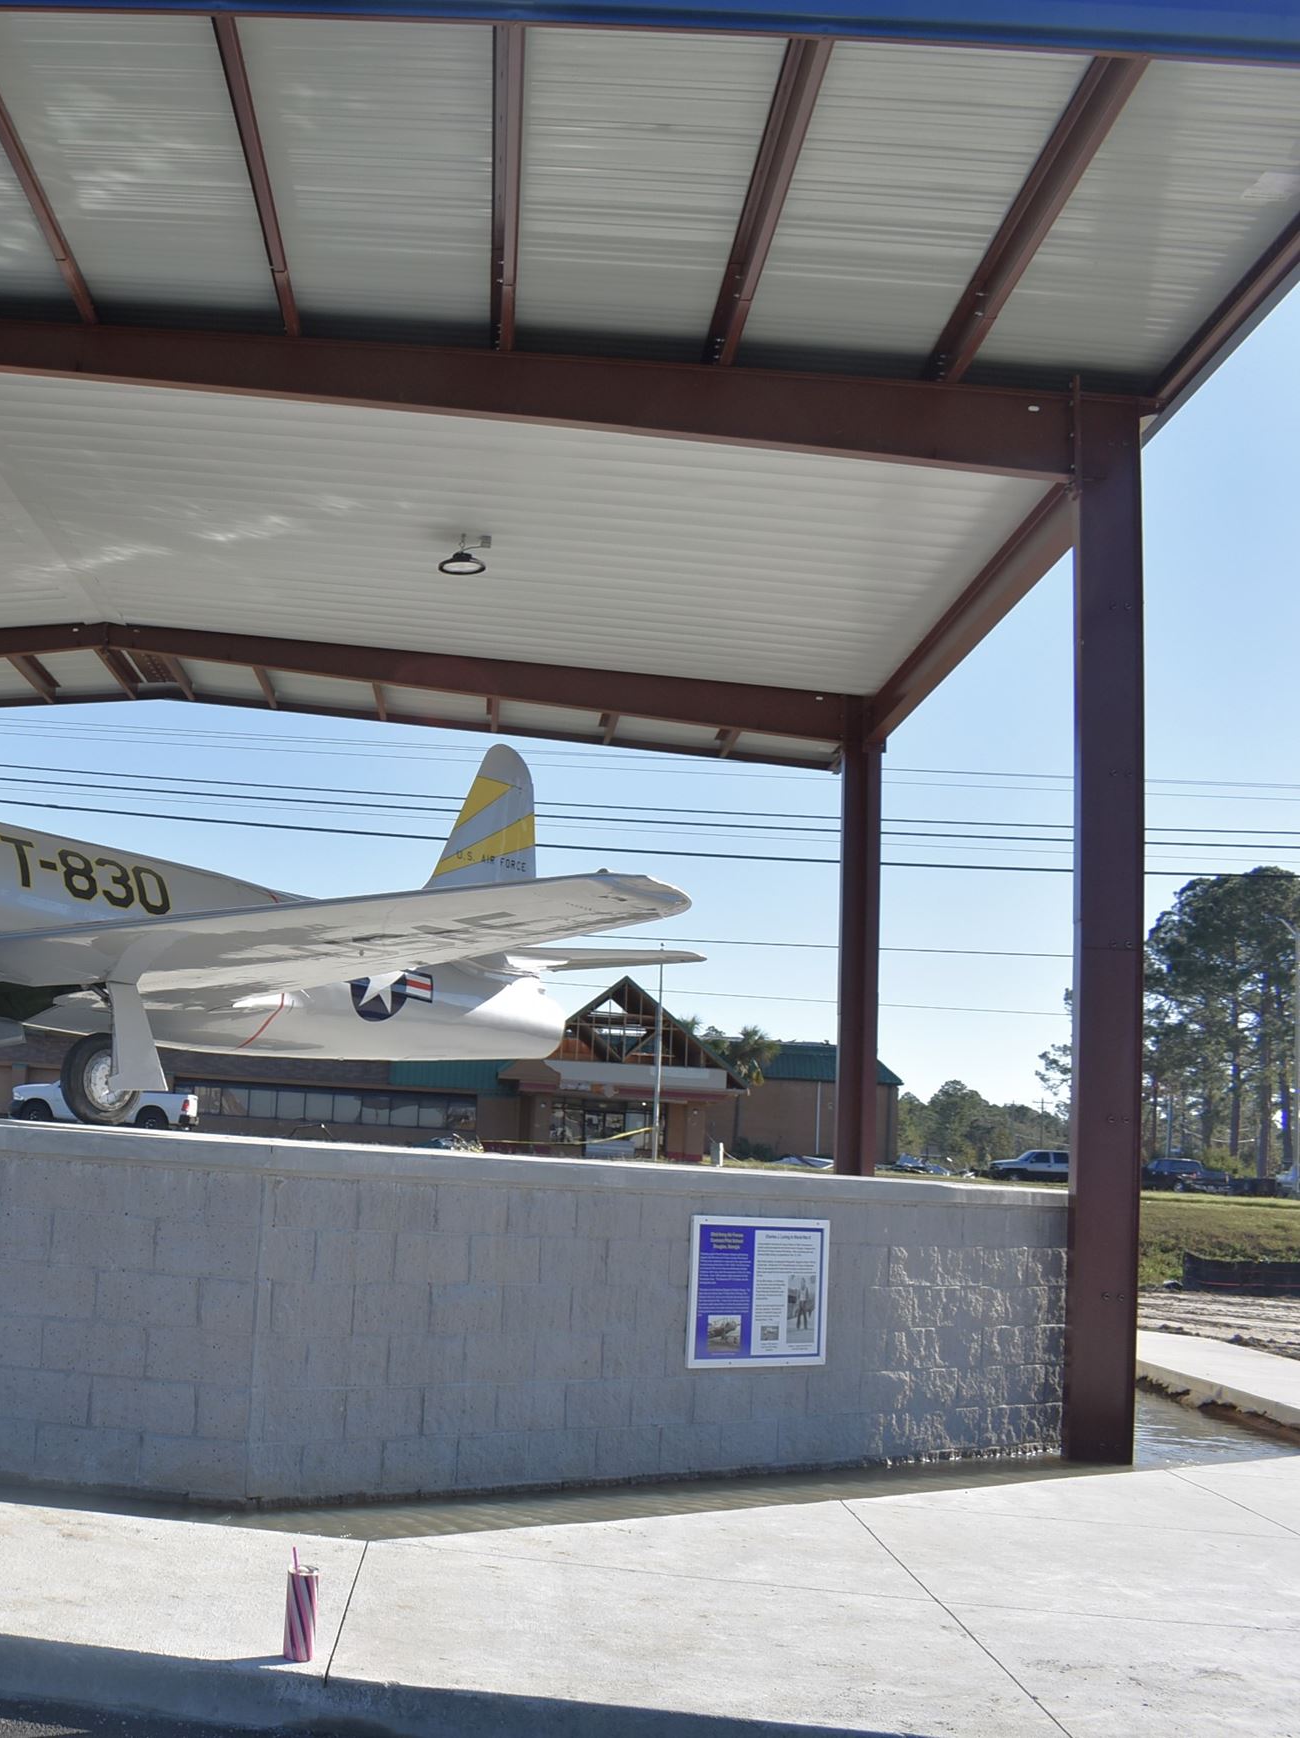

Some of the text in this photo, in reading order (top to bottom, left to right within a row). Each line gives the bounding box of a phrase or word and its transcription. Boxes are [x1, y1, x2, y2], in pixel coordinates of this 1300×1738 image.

[456, 851, 527, 873] U.S. AIR FORCE
